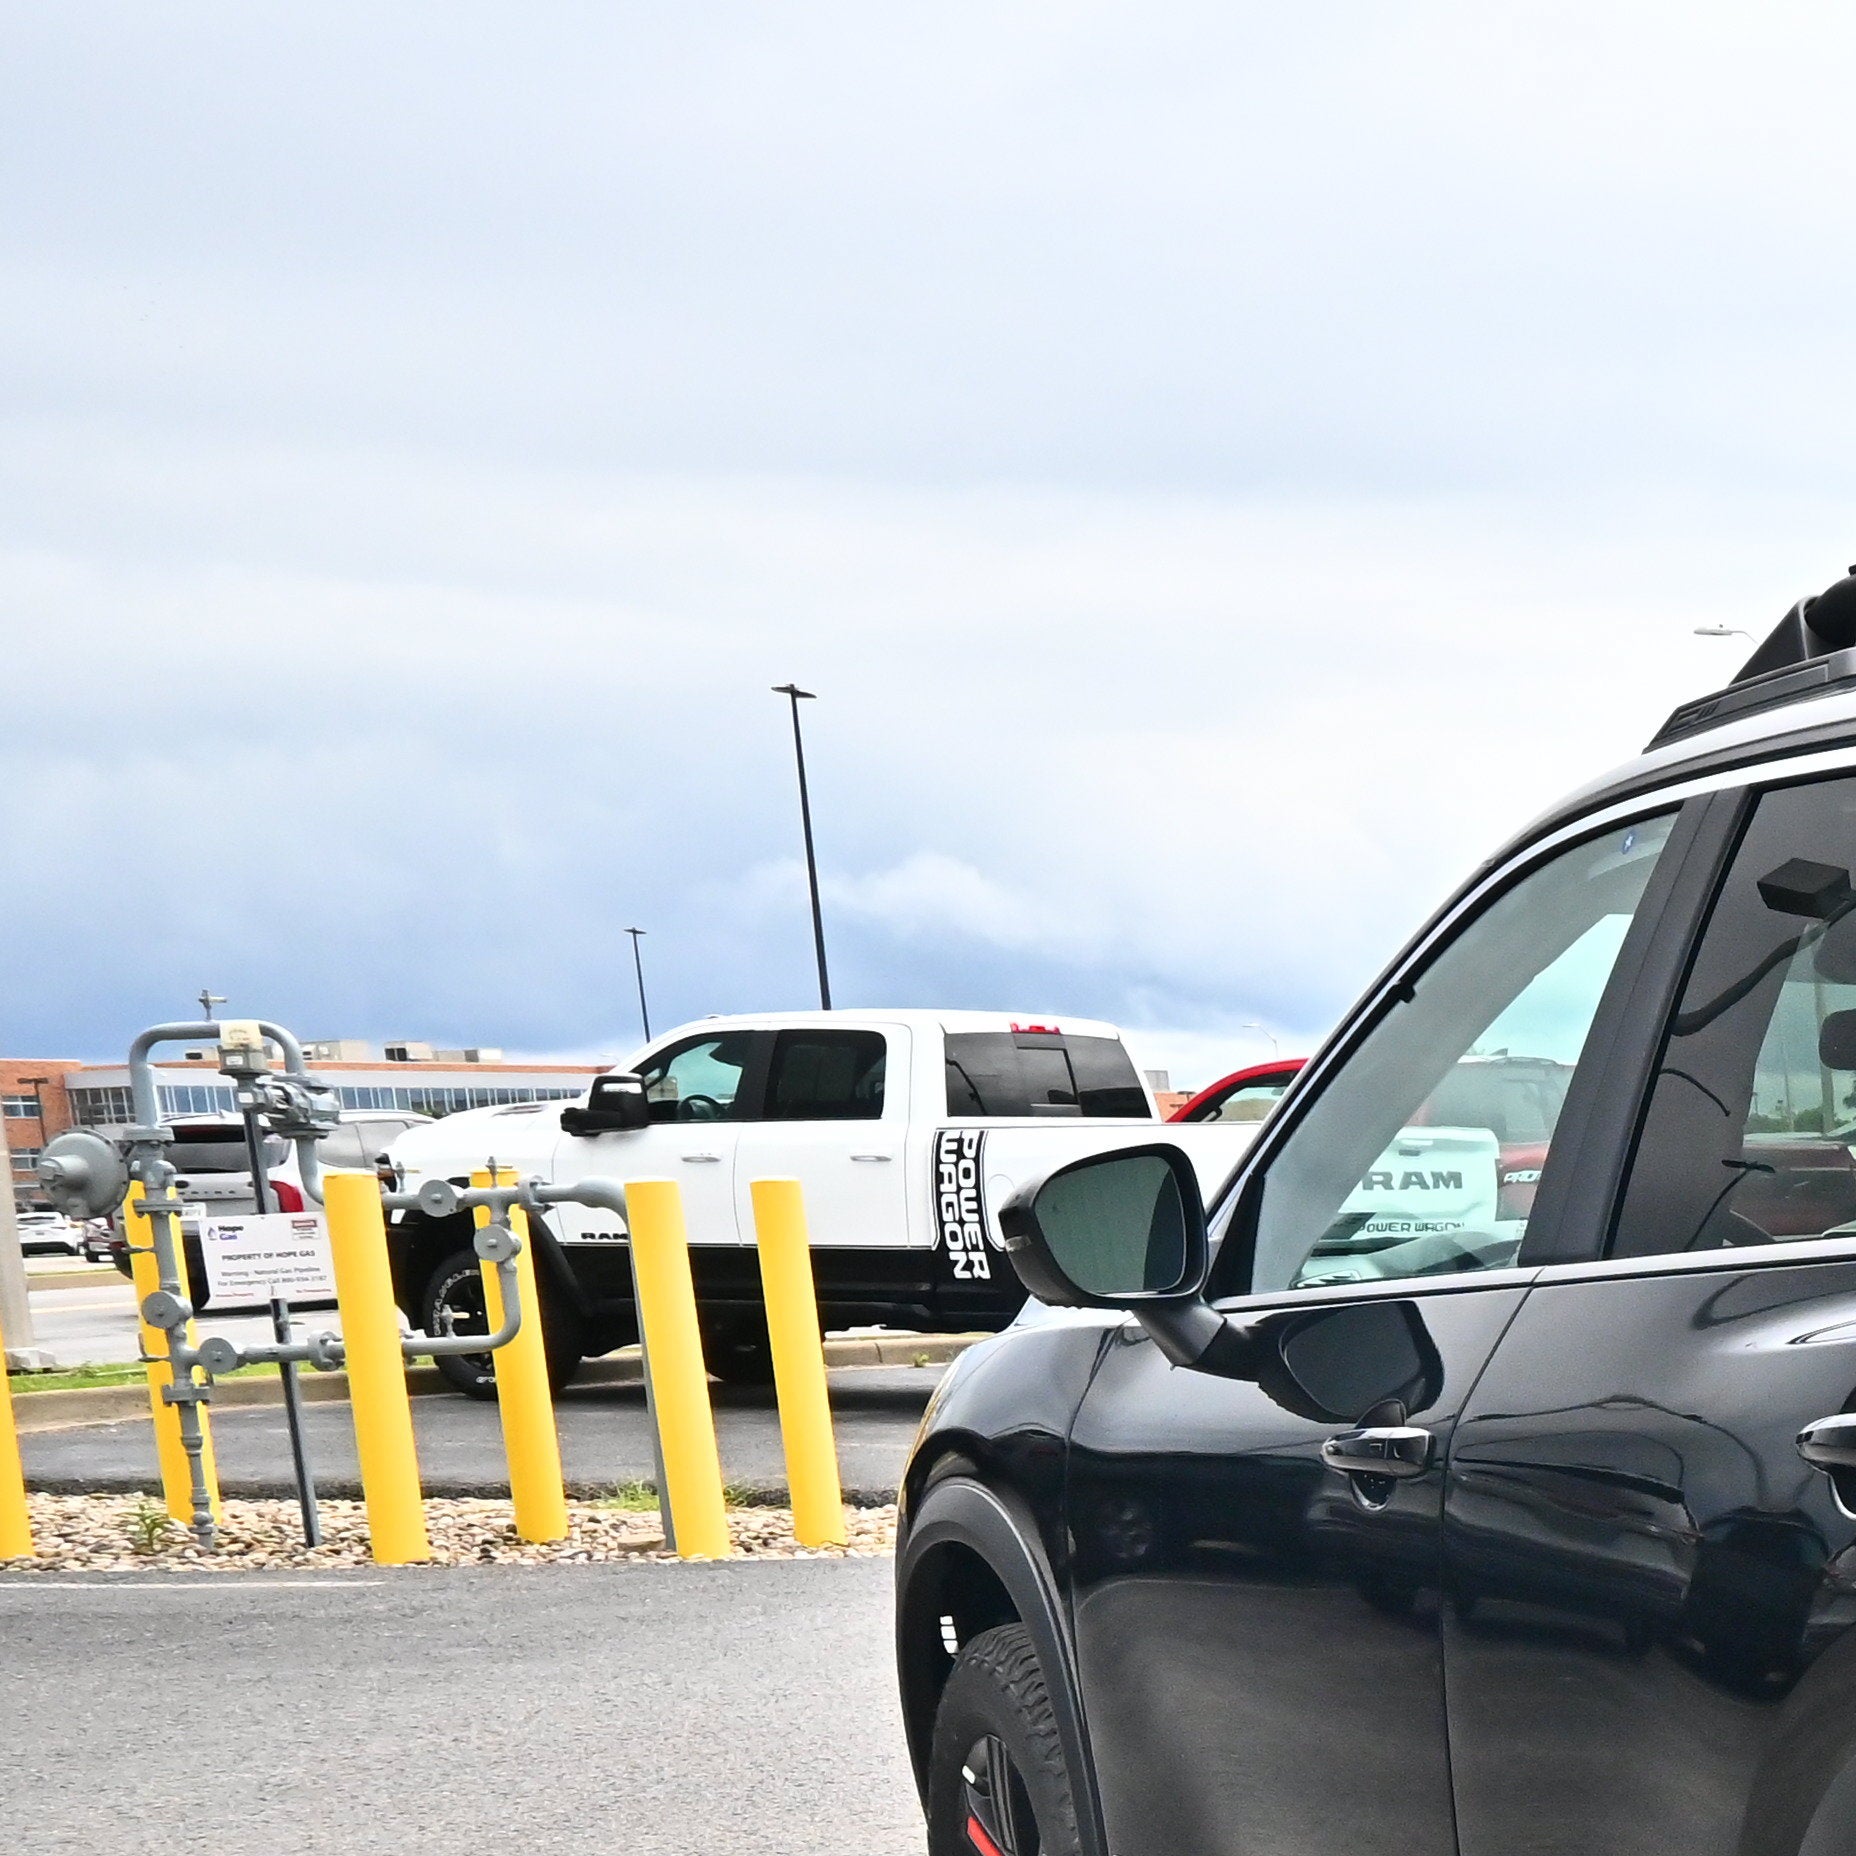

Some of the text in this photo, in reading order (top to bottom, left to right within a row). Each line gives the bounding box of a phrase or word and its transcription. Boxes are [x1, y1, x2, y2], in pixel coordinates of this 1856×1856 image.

[1362, 1171, 1463, 1190] RAM
[939, 1130, 973, 1279] WAGON
[958, 1130, 991, 1279] POWER
[218, 1225, 244, 1233] Hope
[222, 1253, 261, 1261] PROPERTY
